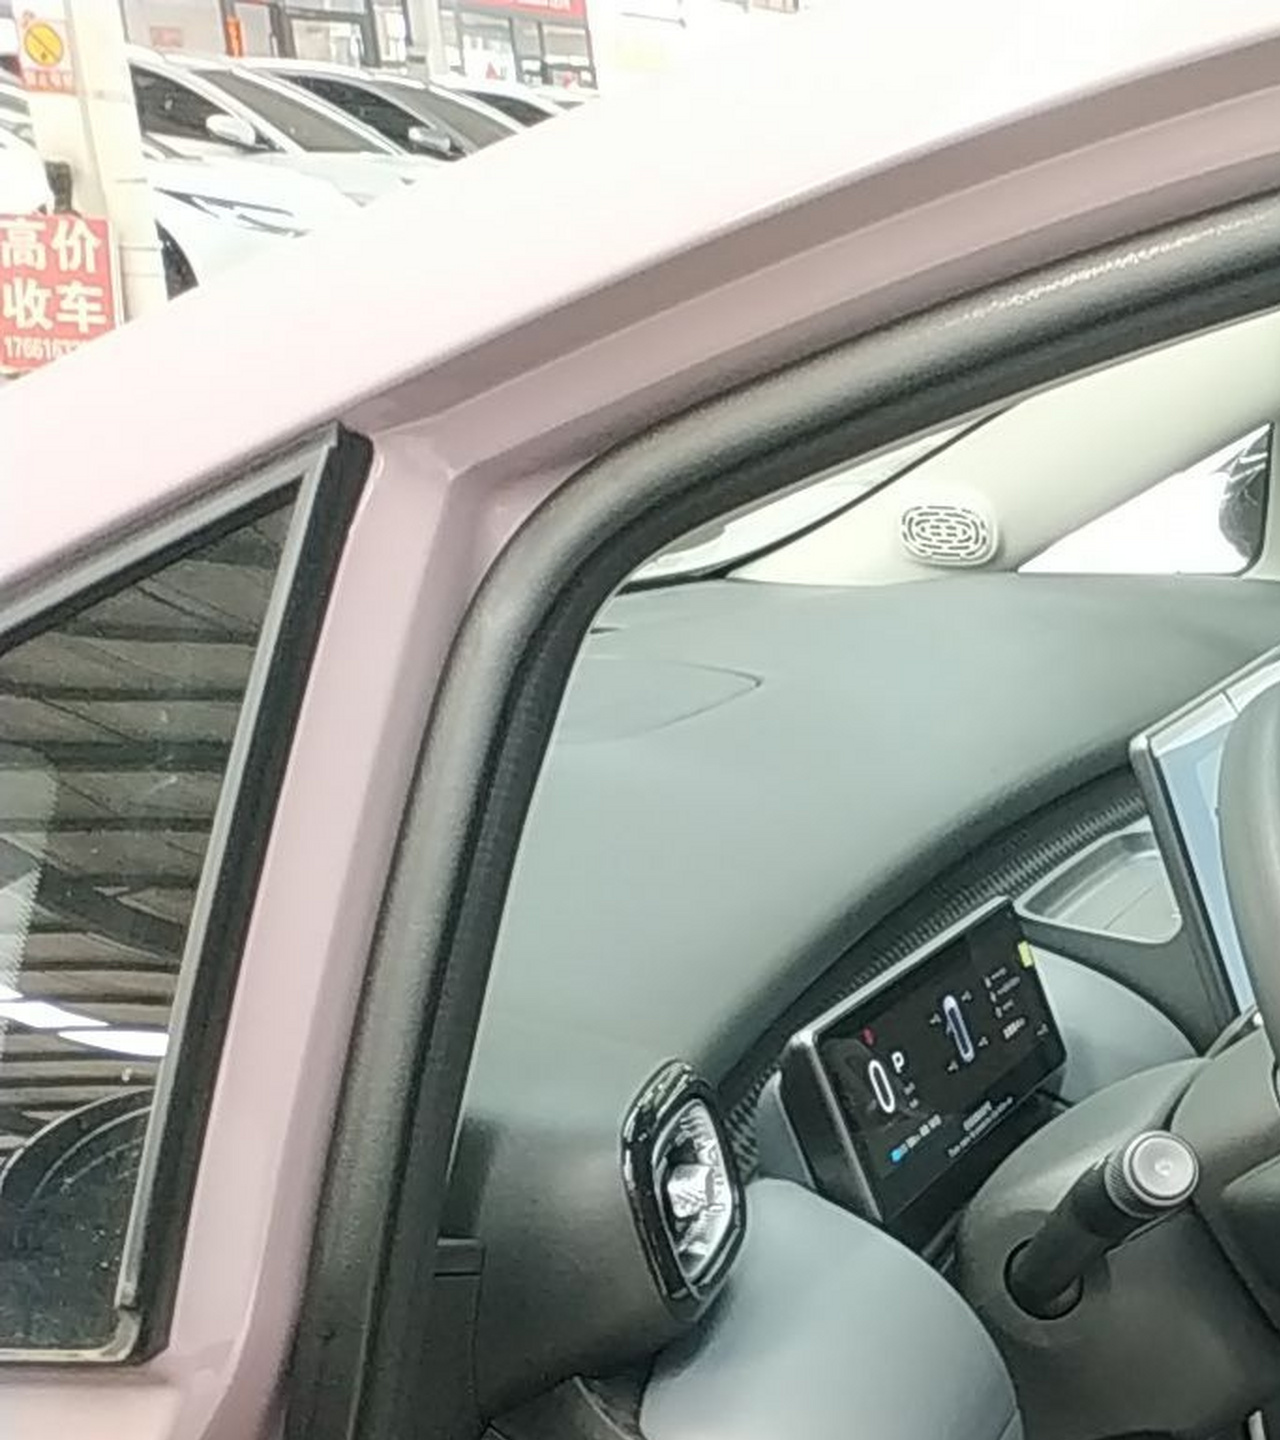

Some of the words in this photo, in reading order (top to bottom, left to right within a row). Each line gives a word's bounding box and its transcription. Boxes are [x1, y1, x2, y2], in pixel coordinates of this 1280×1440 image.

[0, 217, 102, 274] 高价
[2, 276, 108, 334] 收车
[868, 1059, 895, 1113] 0
[891, 1051, 905, 1074] P
